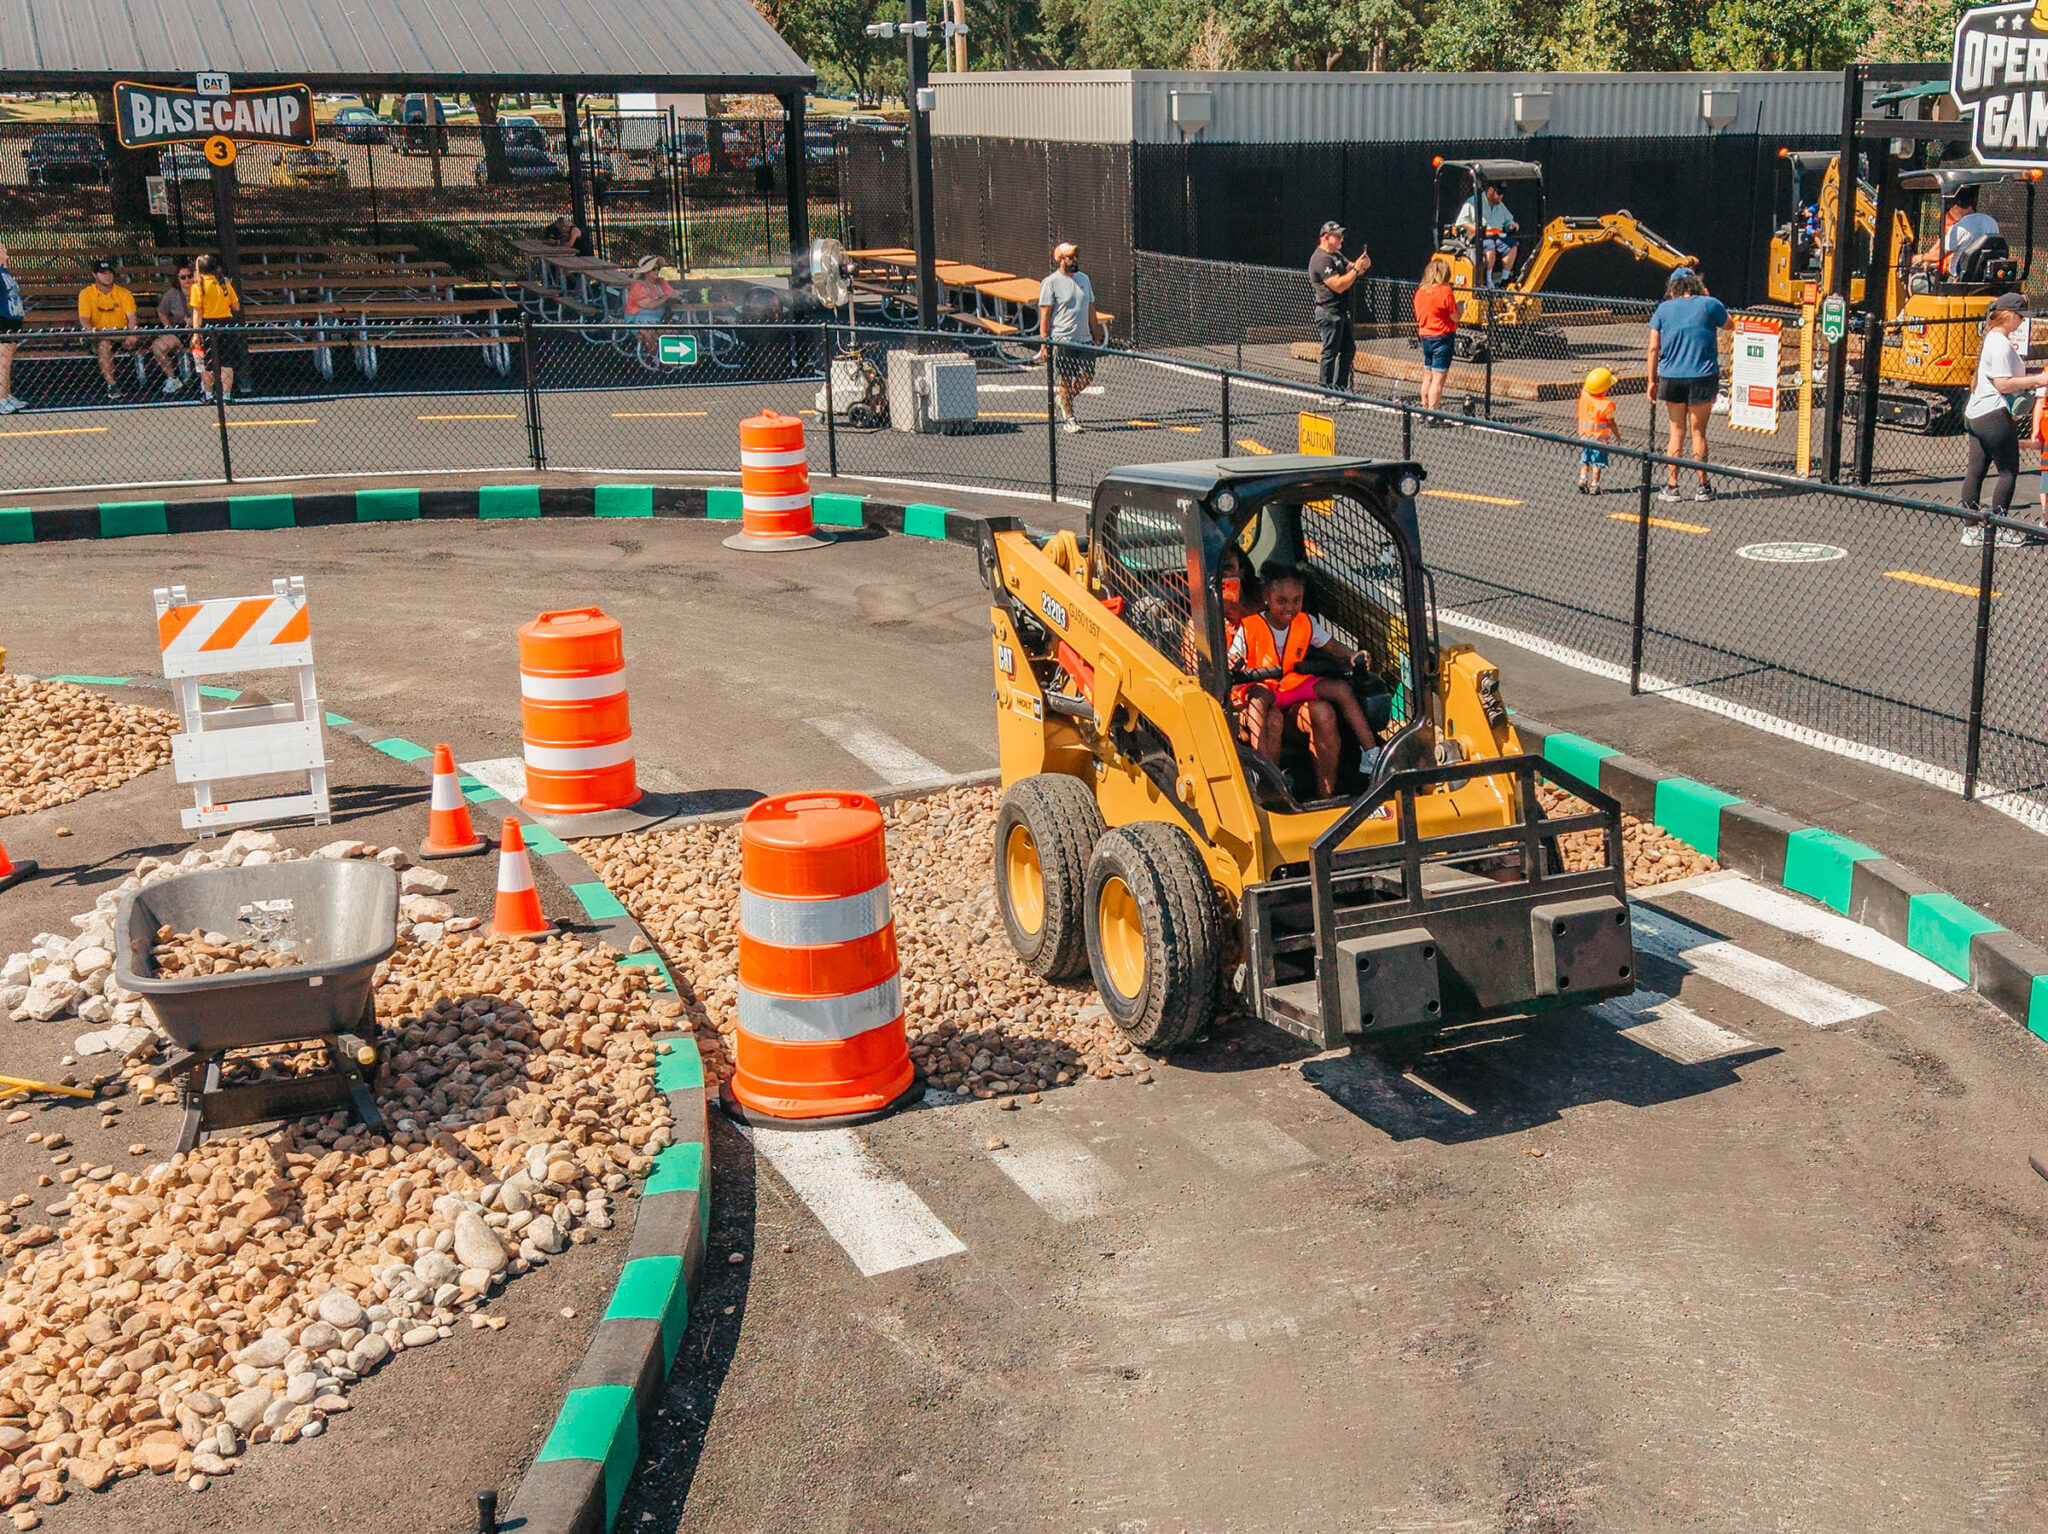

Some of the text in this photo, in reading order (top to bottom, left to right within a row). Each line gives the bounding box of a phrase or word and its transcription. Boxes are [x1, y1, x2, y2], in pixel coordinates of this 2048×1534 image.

[203, 78, 223, 90] CAT
[130, 92, 300, 137] BASECAMP
[214, 141, 228, 160] 3
[1826, 314, 1841, 322] ENTER
[1302, 429, 1332, 451] CAUTION
[1042, 591, 1066, 630] 232D3
[1069, 603, 1100, 639] GJ501357
[998, 645, 1013, 675] CAT
[1016, 697, 1032, 711] HOLT
